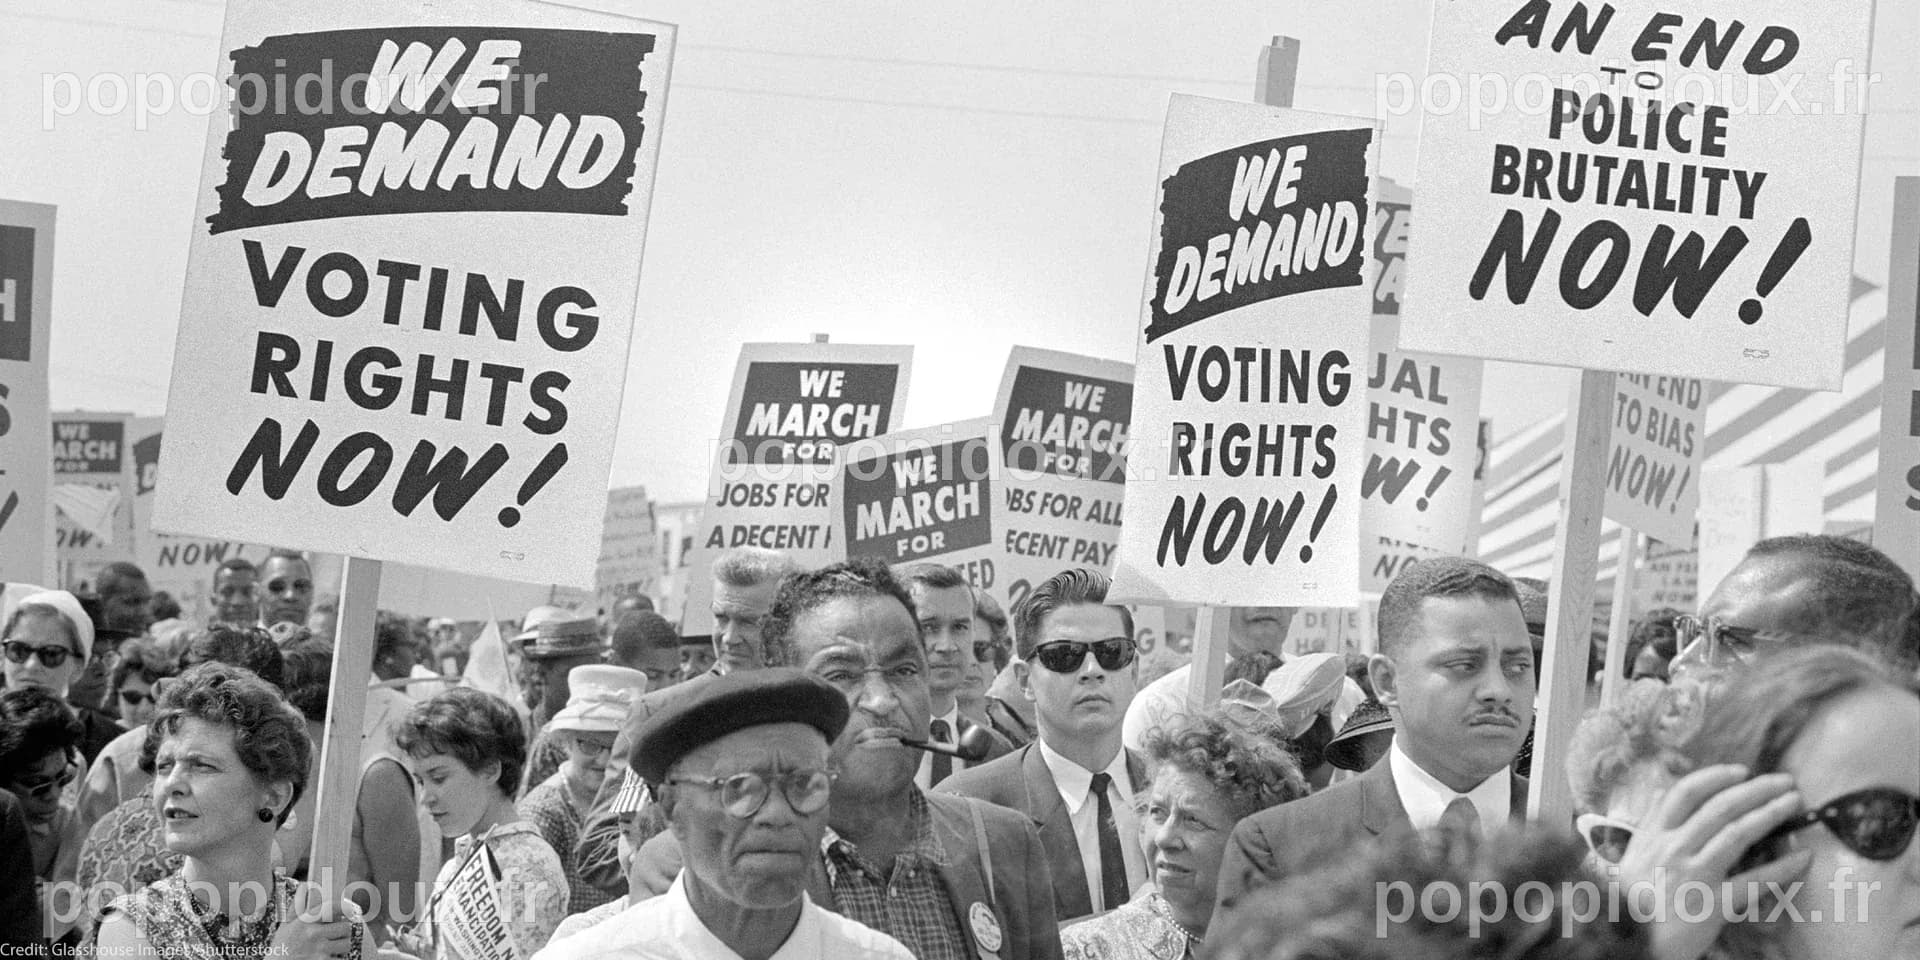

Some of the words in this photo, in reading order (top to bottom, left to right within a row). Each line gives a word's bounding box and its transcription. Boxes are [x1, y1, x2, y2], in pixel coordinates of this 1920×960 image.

[1495, 0, 1615, 55] AN
[1631, 12, 1799, 75] END
[365, 37, 521, 114] WE
[1601, 66, 1663, 91] TO
[1549, 88, 1729, 158] POLICE
[242, 112, 625, 206] DEMAND
[1229, 145, 1307, 221] WE
[1491, 144, 1768, 219] BRUTALITY
[1163, 201, 1358, 314] DEMAND
[1469, 208, 1812, 325] NOW!
[242, 239, 600, 352] VOTING
[250, 331, 572, 435] RIGHTS
[800, 370, 845, 398] WE
[1064, 382, 1106, 413] WE
[1163, 344, 1351, 407] VOTING
[58, 424, 90, 440] WE
[745, 403, 880, 437] MARCH
[1012, 408, 1130, 457] MARCH
[1368, 402, 1451, 456] HTS
[1617, 392, 1642, 434] TO
[1645, 406, 1695, 458] BIAS
[54, 440, 117, 460] ARCH
[226, 417, 569, 528] NOW!
[782, 443, 832, 460] FOR
[892, 455, 938, 489] WE
[1043, 451, 1089, 473] FOR
[1169, 422, 1337, 479] RIGHTS
[1606, 445, 1690, 514] NOW!
[716, 483, 778, 507] JOBS
[783, 483, 830, 507] FOR
[856, 482, 980, 541] MARCH
[1039, 492, 1082, 519] FOR
[1085, 499, 1122, 527] ALL
[1360, 453, 1452, 512] W!
[705, 525, 724, 548] A
[730, 525, 819, 548] DECENT
[897, 531, 945, 556] FOR
[1006, 529, 1070, 559] ECENT
[1071, 538, 1117, 566] PAY
[1157, 484, 1338, 567] NOW!
[454, 876, 500, 960] EMANCIPATIO
[465, 854, 507, 945] FREEDOM
